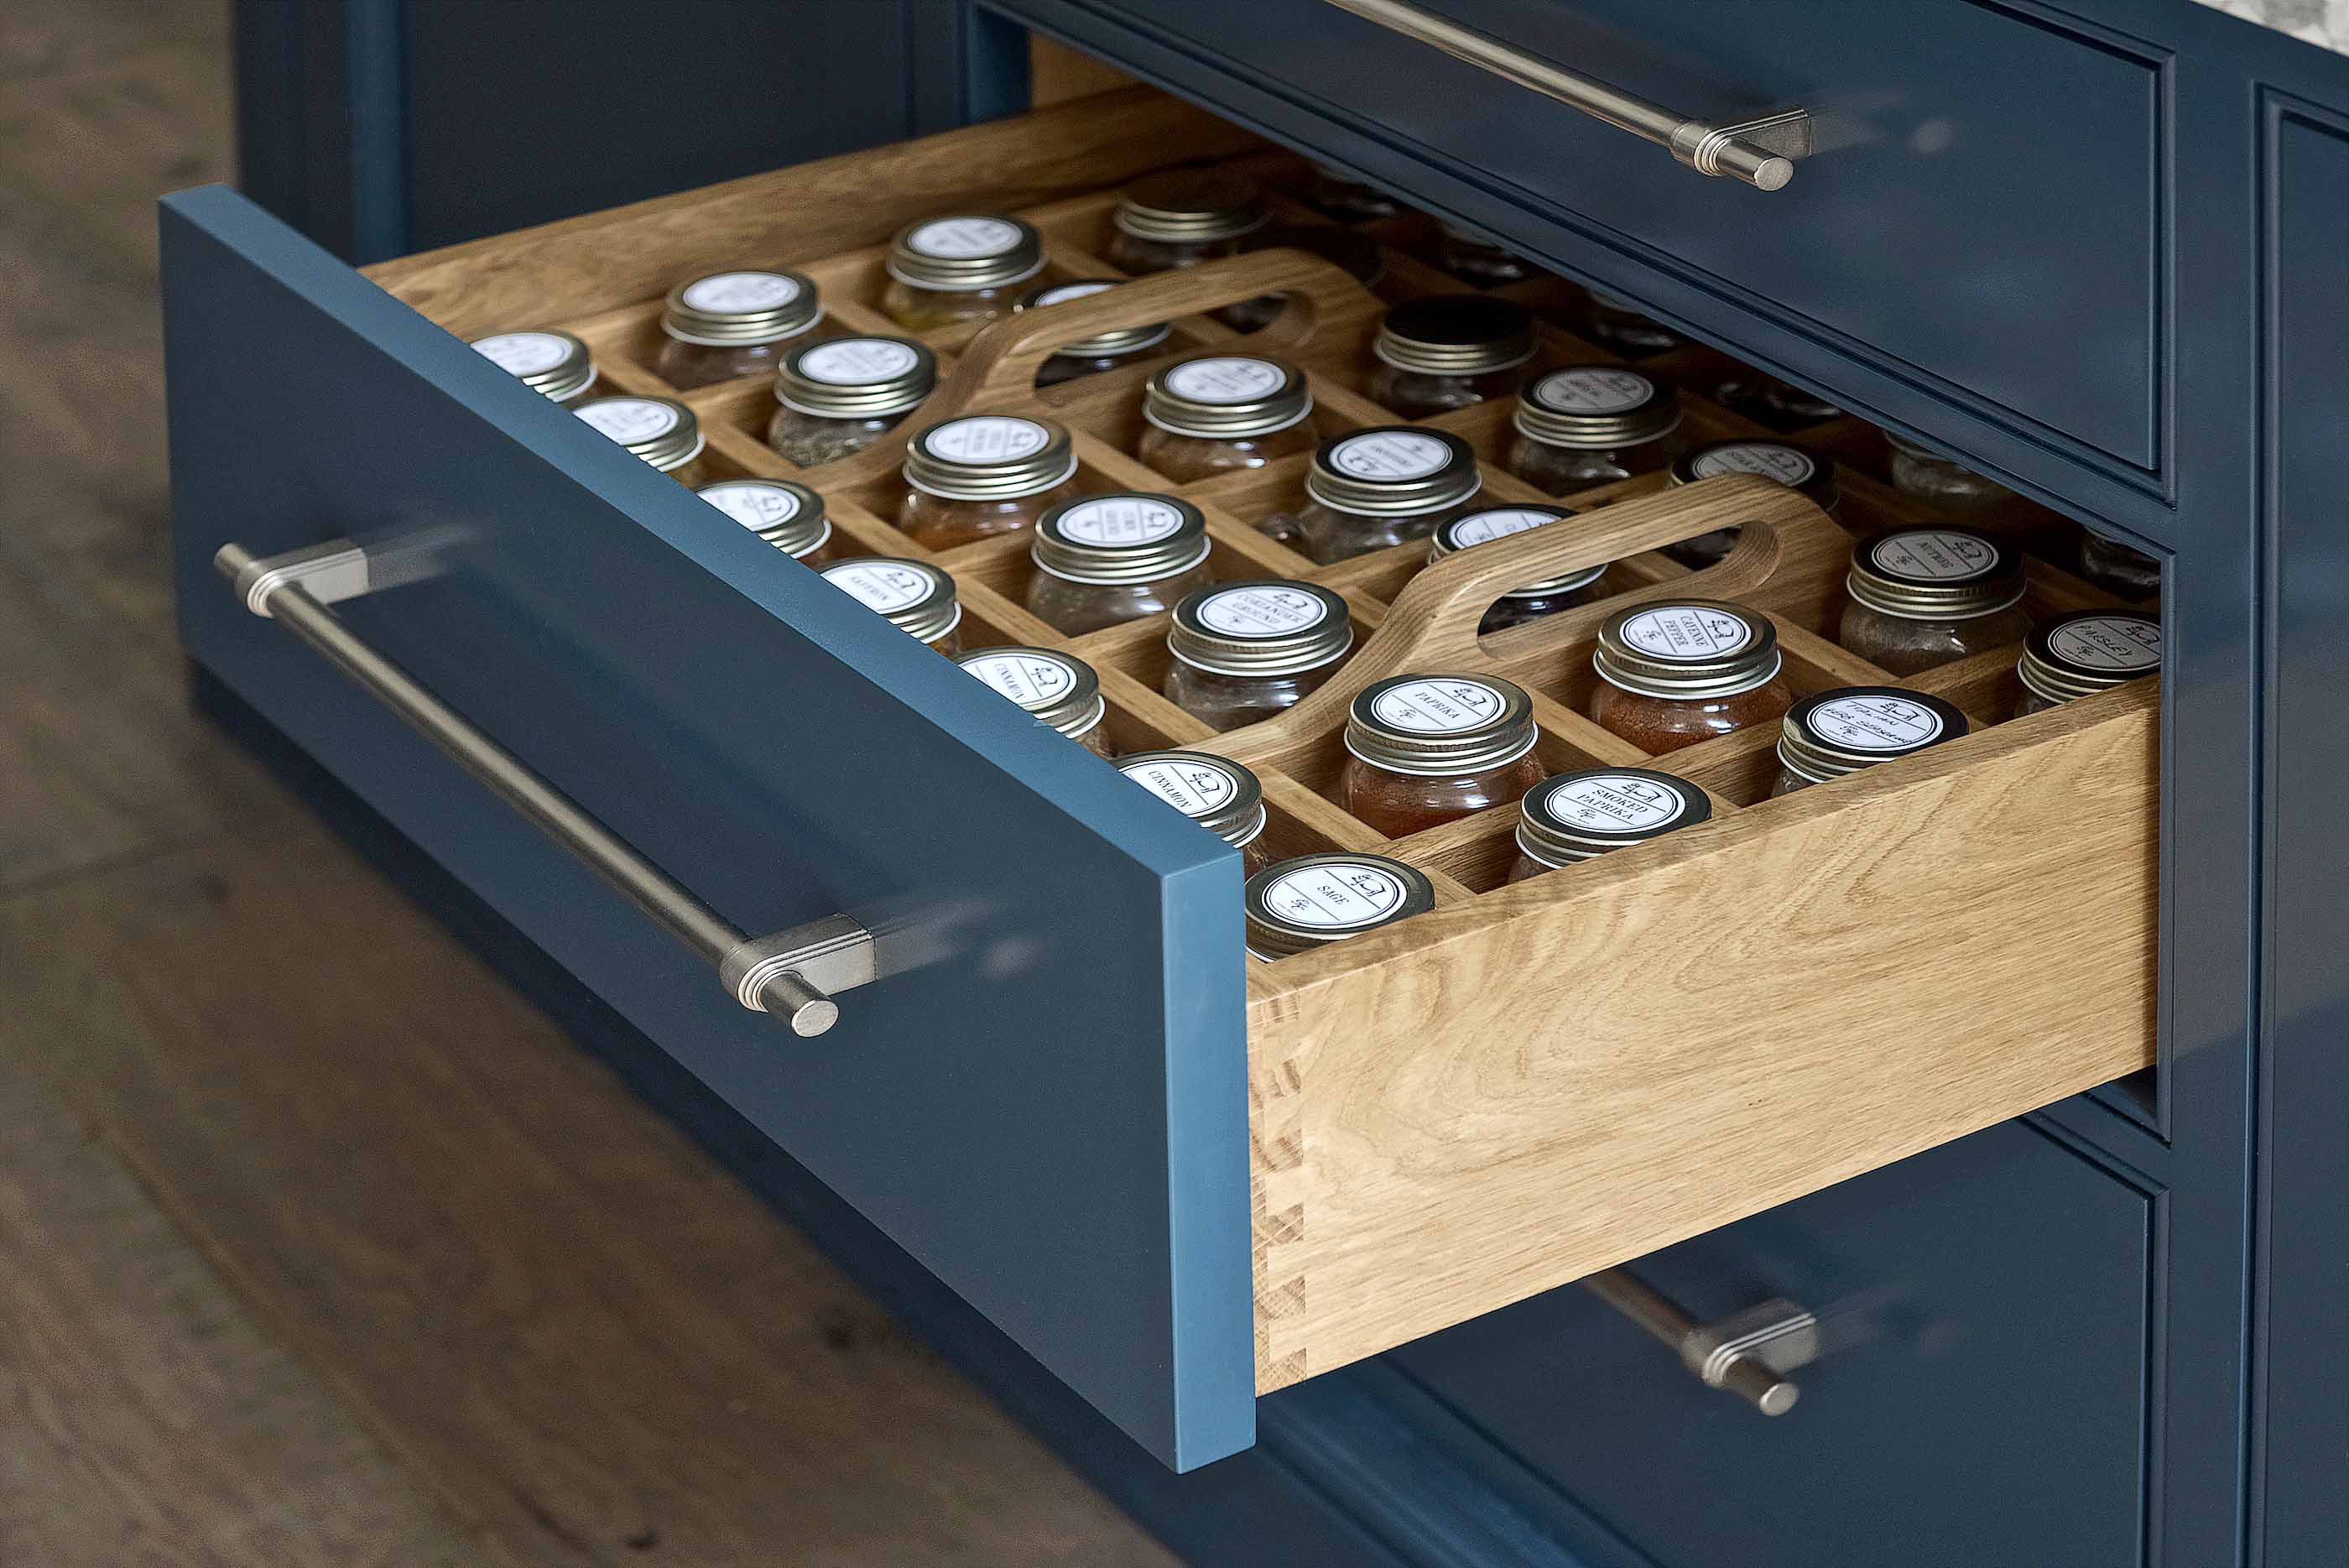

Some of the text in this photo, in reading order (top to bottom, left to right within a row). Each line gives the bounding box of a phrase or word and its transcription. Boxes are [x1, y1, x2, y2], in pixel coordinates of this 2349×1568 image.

[1663, 619, 1690, 646] PEPPER
[1680, 615, 1709, 647] CAYENNE
[1414, 691, 1461, 719] PAPRIKA
[1148, 770, 1192, 808] CINNAMON
[1591, 789, 1648, 814] SMOKED
[1576, 794, 1635, 820] PAPRIKA
[1316, 885, 1350, 905] SAGE
